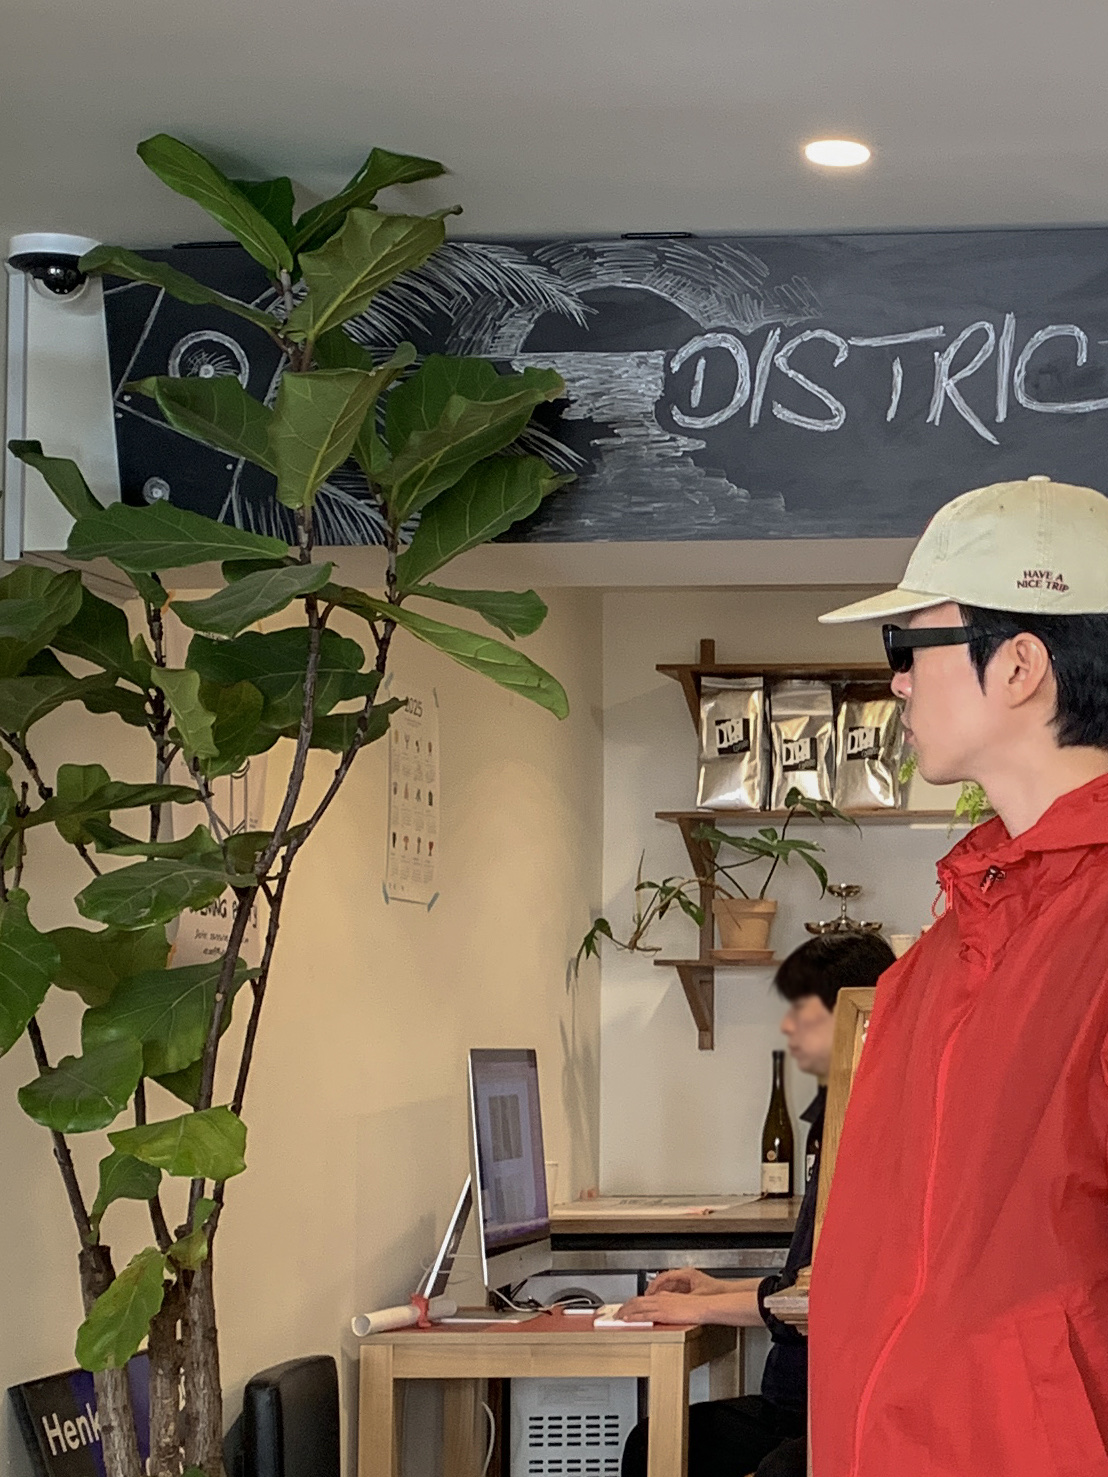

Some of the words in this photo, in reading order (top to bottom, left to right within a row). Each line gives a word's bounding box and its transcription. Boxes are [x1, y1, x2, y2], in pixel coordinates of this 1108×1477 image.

[1023, 570, 1053, 580] HAVE
[1056, 573, 1063, 582] A
[1016, 580, 1043, 589] NICE
[1046, 581, 1070, 593] TRIP
